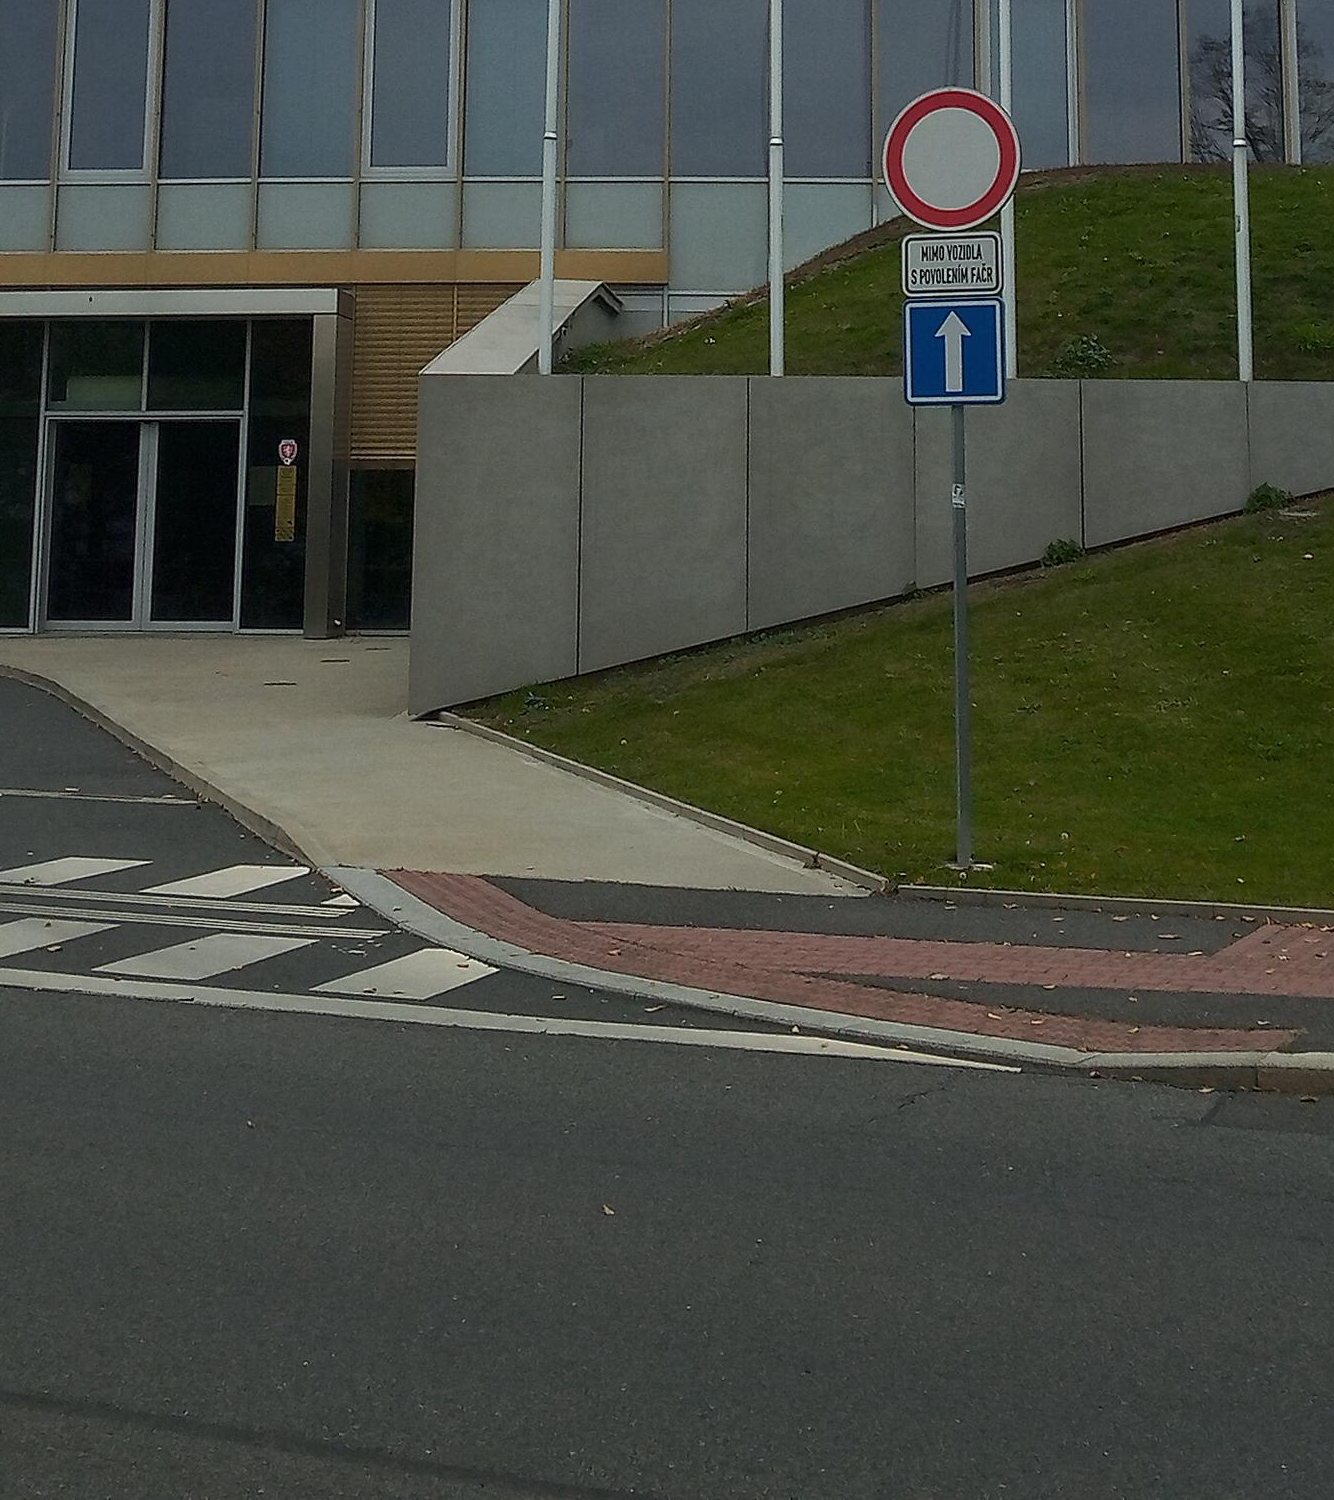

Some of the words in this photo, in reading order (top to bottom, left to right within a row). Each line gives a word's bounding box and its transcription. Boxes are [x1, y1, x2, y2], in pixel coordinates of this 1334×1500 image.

[921, 245, 945, 262] MIMO
[947, 243, 983, 261] VOZIDLA
[911, 268, 918, 285] S
[919, 264, 968, 285] POVOLENÍM
[970, 262, 993, 283] FAČR
